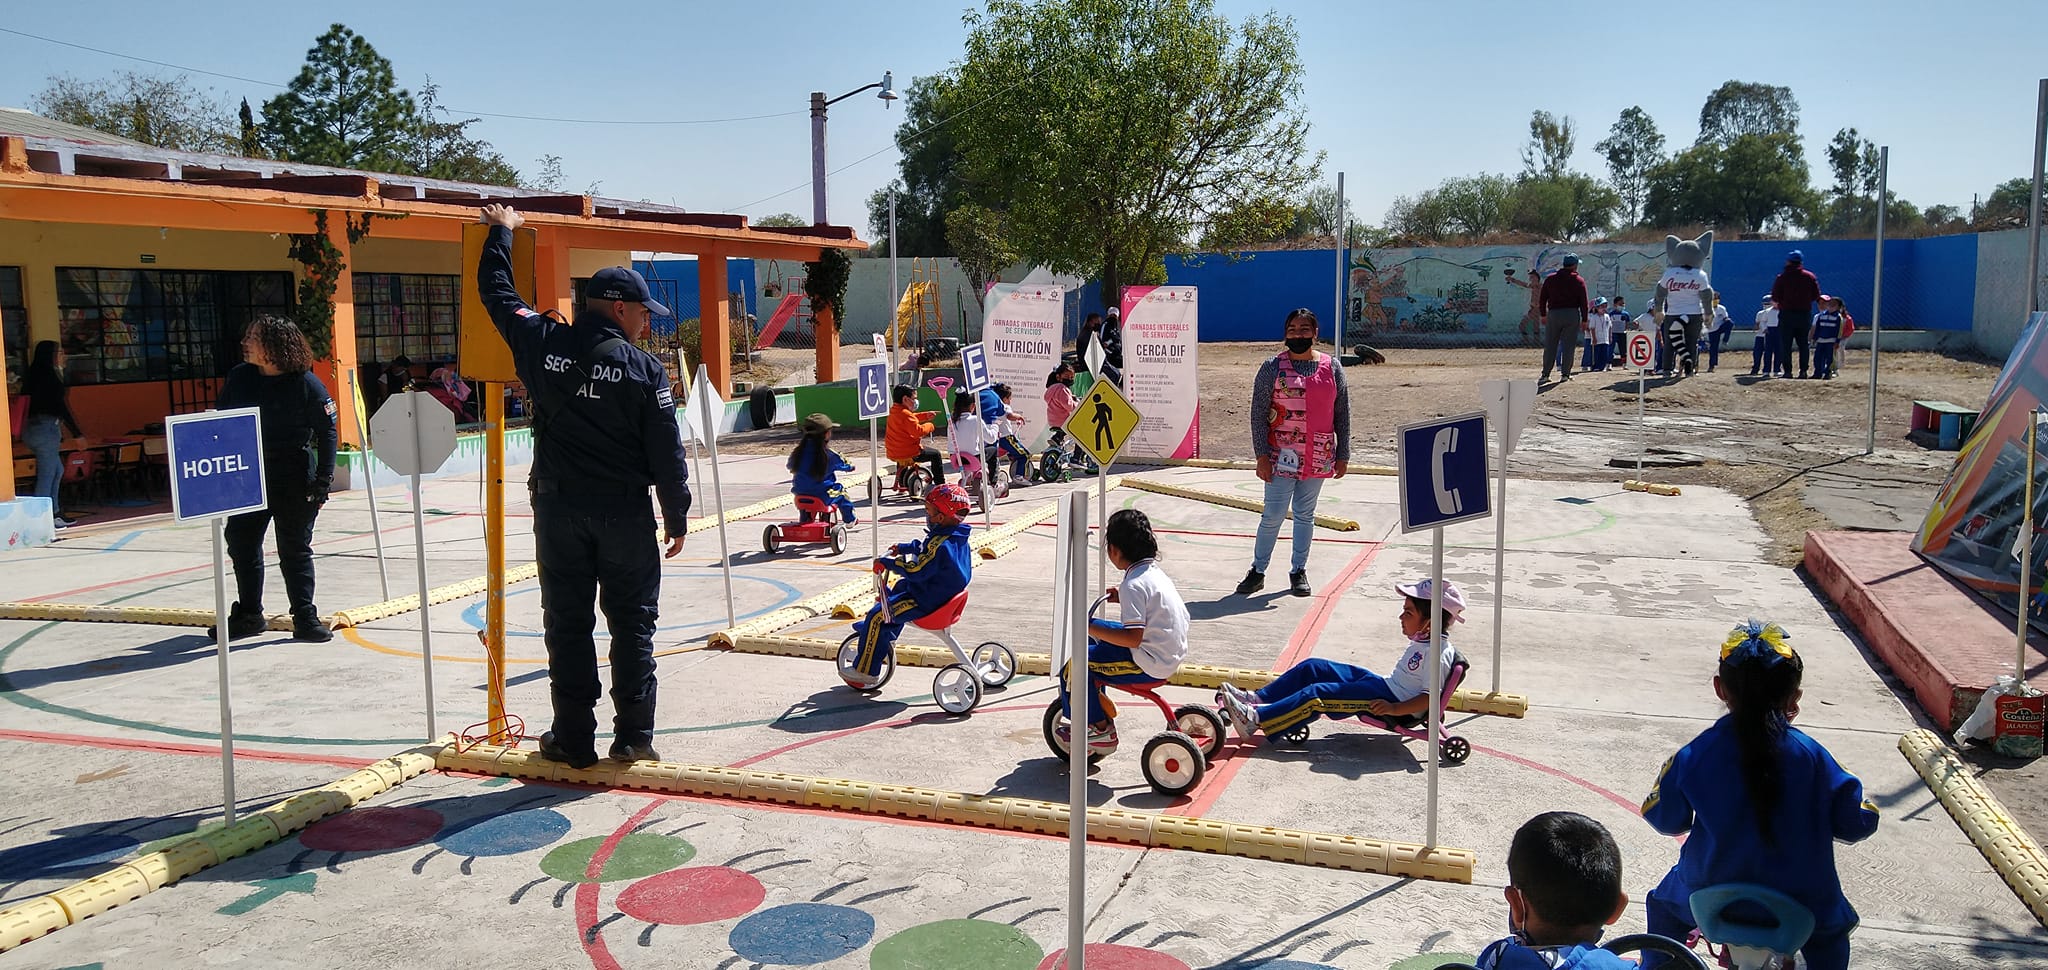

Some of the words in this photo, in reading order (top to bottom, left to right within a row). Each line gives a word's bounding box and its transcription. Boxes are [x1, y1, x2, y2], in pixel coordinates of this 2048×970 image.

[992, 319, 1020, 328] JORNADAS
[1021, 321, 1054, 329] INTEGRALES
[1014, 328, 1042, 336] SERVICIOS
[1130, 323, 1156, 331] JORNADAS
[994, 339, 1052, 355] NUTRICIÓN
[1136, 344, 1167, 357] CERCA
[1170, 344, 1186, 357] DIF
[1634, 340, 1651, 360] E
[544, 353, 623, 383] SEGDAD
[966, 348, 986, 387] E
[183, 454, 250, 479] HOTEL
